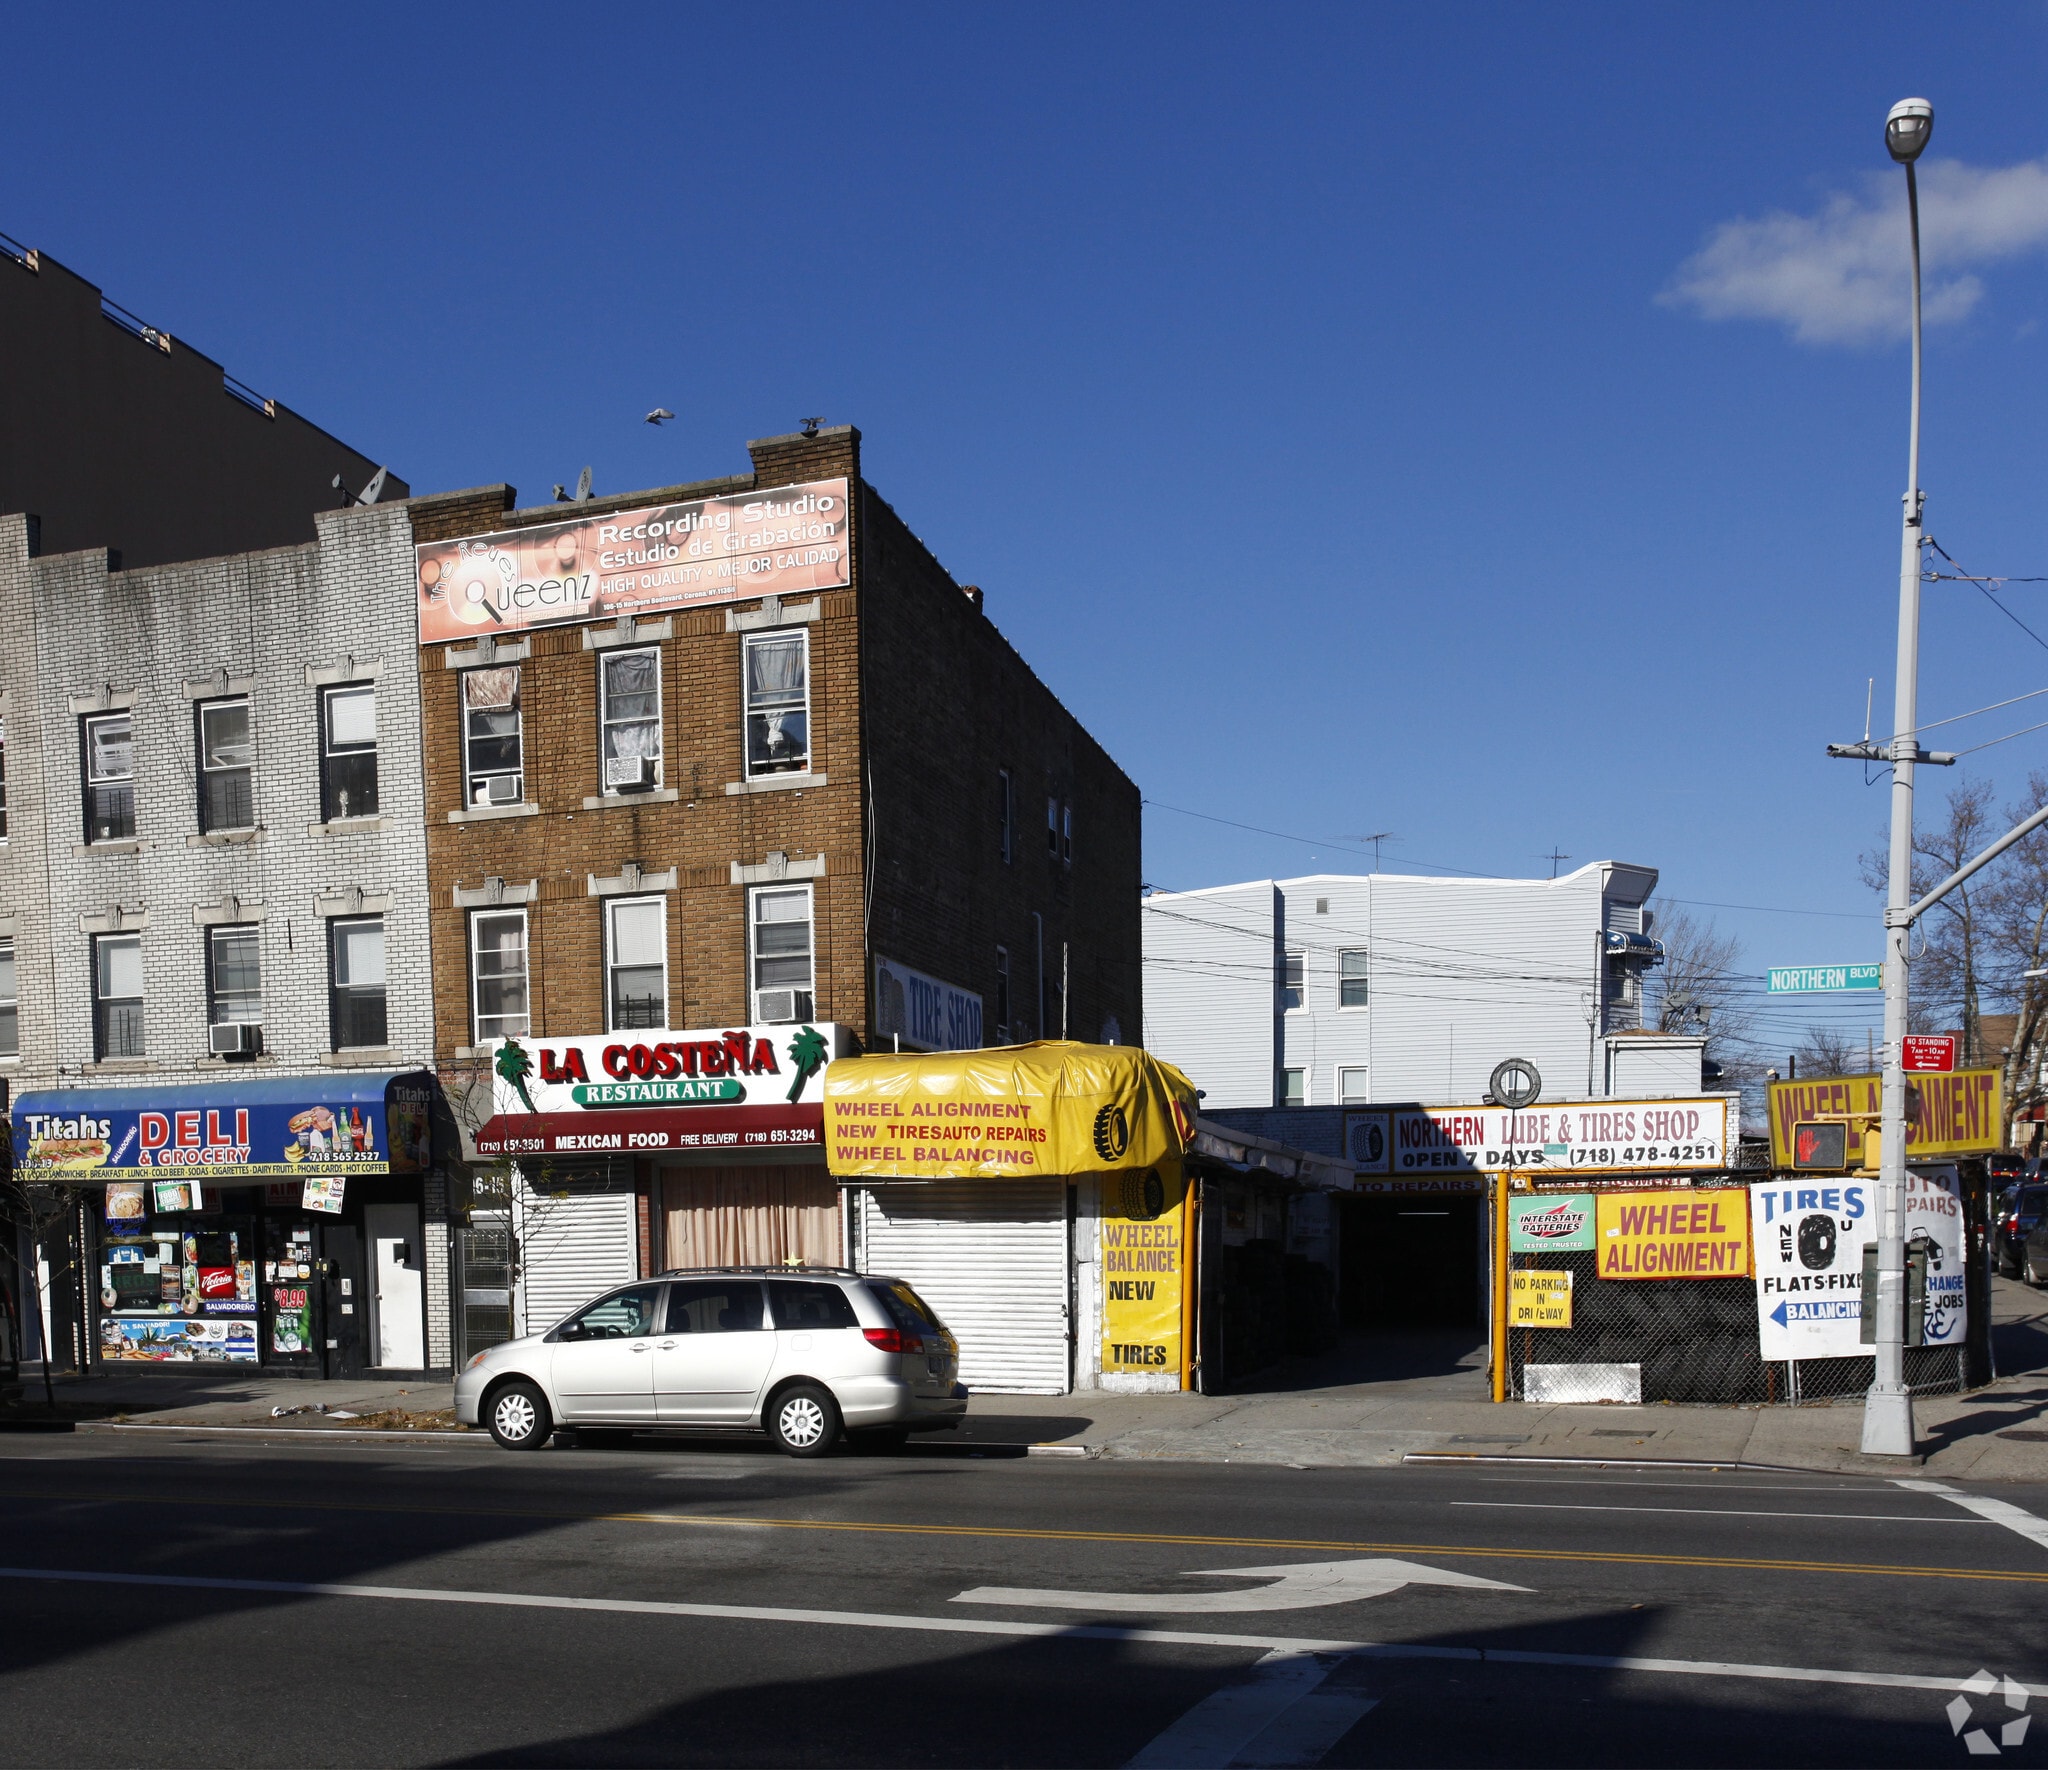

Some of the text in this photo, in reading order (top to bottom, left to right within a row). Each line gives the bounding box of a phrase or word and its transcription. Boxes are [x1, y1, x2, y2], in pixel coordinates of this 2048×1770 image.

[599, 493, 834, 544] Recording Studio
[600, 521, 835, 569] Estudio de Grabación
[430, 541, 516, 603] The Reyes
[601, 547, 840, 595] HIGH QUALITY MEJOR CALIDAD
[623, 600, 651, 609] Northern
[1771, 968, 1878, 990] NORTHERN BLVD
[909, 976, 982, 1050] TIRE SHOP
[1907, 1038, 1950, 1047] NO STANDING
[539, 1031, 779, 1080] LA COSTEÑA
[394, 1085, 431, 1102] Titahs
[586, 1082, 724, 1103] RESTAURANT
[400, 1102, 429, 1115] DELI
[834, 1102, 1032, 1120] WHEEL ALIGNMENT
[1349, 1114, 1387, 1123] WHEEL
[25, 1114, 111, 1140] Titahs
[139, 1109, 249, 1149] DELI
[836, 1124, 877, 1139] NEW
[986, 1126, 1046, 1143] REPAIRS
[1400, 1109, 1700, 1148] NORTHERN LUBE & TIRES SHOP
[111, 1126, 138, 1165] SALVADOREÑO
[555, 1134, 622, 1149] MEXICAN
[628, 1132, 669, 1147] FOOD
[680, 1133, 700, 1145] FREE
[702, 1132, 739, 1144] DELIVERY
[745, 1131, 767, 1143] (718)
[770, 1128, 816, 1142] 651-3294
[138, 1147, 251, 1166] & GROCERY
[311, 1151, 380, 1161] 718 565 2527
[836, 1146, 1035, 1165] WHEEL BALANCING
[1402, 1151, 1458, 1167] OPEN
[1466, 1151, 1478, 1166] 7
[1486, 1149, 1545, 1166] DAYS
[1569, 1148, 1616, 1166] (718)
[1623, 1145, 1715, 1162] 478-4251
[49, 1169, 87, 1178] SANDWICHES
[90, 1168, 124, 1178] BREAKFAST
[127, 1168, 149, 1178] LUNCH
[151, 1168, 169, 1177] COLD
[169, 1168, 185, 1177] BEER
[188, 1167, 209, 1176] SODAS
[212, 1166, 249, 1175] CIGARETTES
[252, 1165, 271, 1174] DAIRY
[272, 1164, 294, 1174] FRUITS
[297, 1164, 320, 1173] PHONE
[321, 1163, 343, 1173] CARDS
[346, 1163, 361, 1172] HOT
[361, 1163, 387, 1172] COFFEE
[1355, 1162, 1387, 1171] ALANCE
[1391, 1181, 1476, 1192] REPAIRS
[1905, 1174, 1951, 1194] UTO
[1761, 1187, 1865, 1224] TIRES
[1520, 1213, 1585, 1223] INTERSTATE
[1522, 1223, 1580, 1232] BATTERIES
[1620, 1203, 1726, 1236] WHEEL
[1105, 1225, 1178, 1248] WHEEL
[1107, 1250, 1175, 1272] BALANCE
[1604, 1241, 1742, 1273] ALIGNMENT
[201, 1270, 233, 1292] Victoria
[1109, 1281, 1155, 1301] NEW
[1514, 1278, 1568, 1291] NO PARKING
[206, 1302, 255, 1312] SALVADOREÑO
[274, 1289, 306, 1308] $8.99
[1536, 1293, 1545, 1305] IN
[1934, 1294, 1964, 1309] JOBS
[1786, 1302, 1861, 1319] BALANCIN
[1111, 1344, 1167, 1365] TIRES
